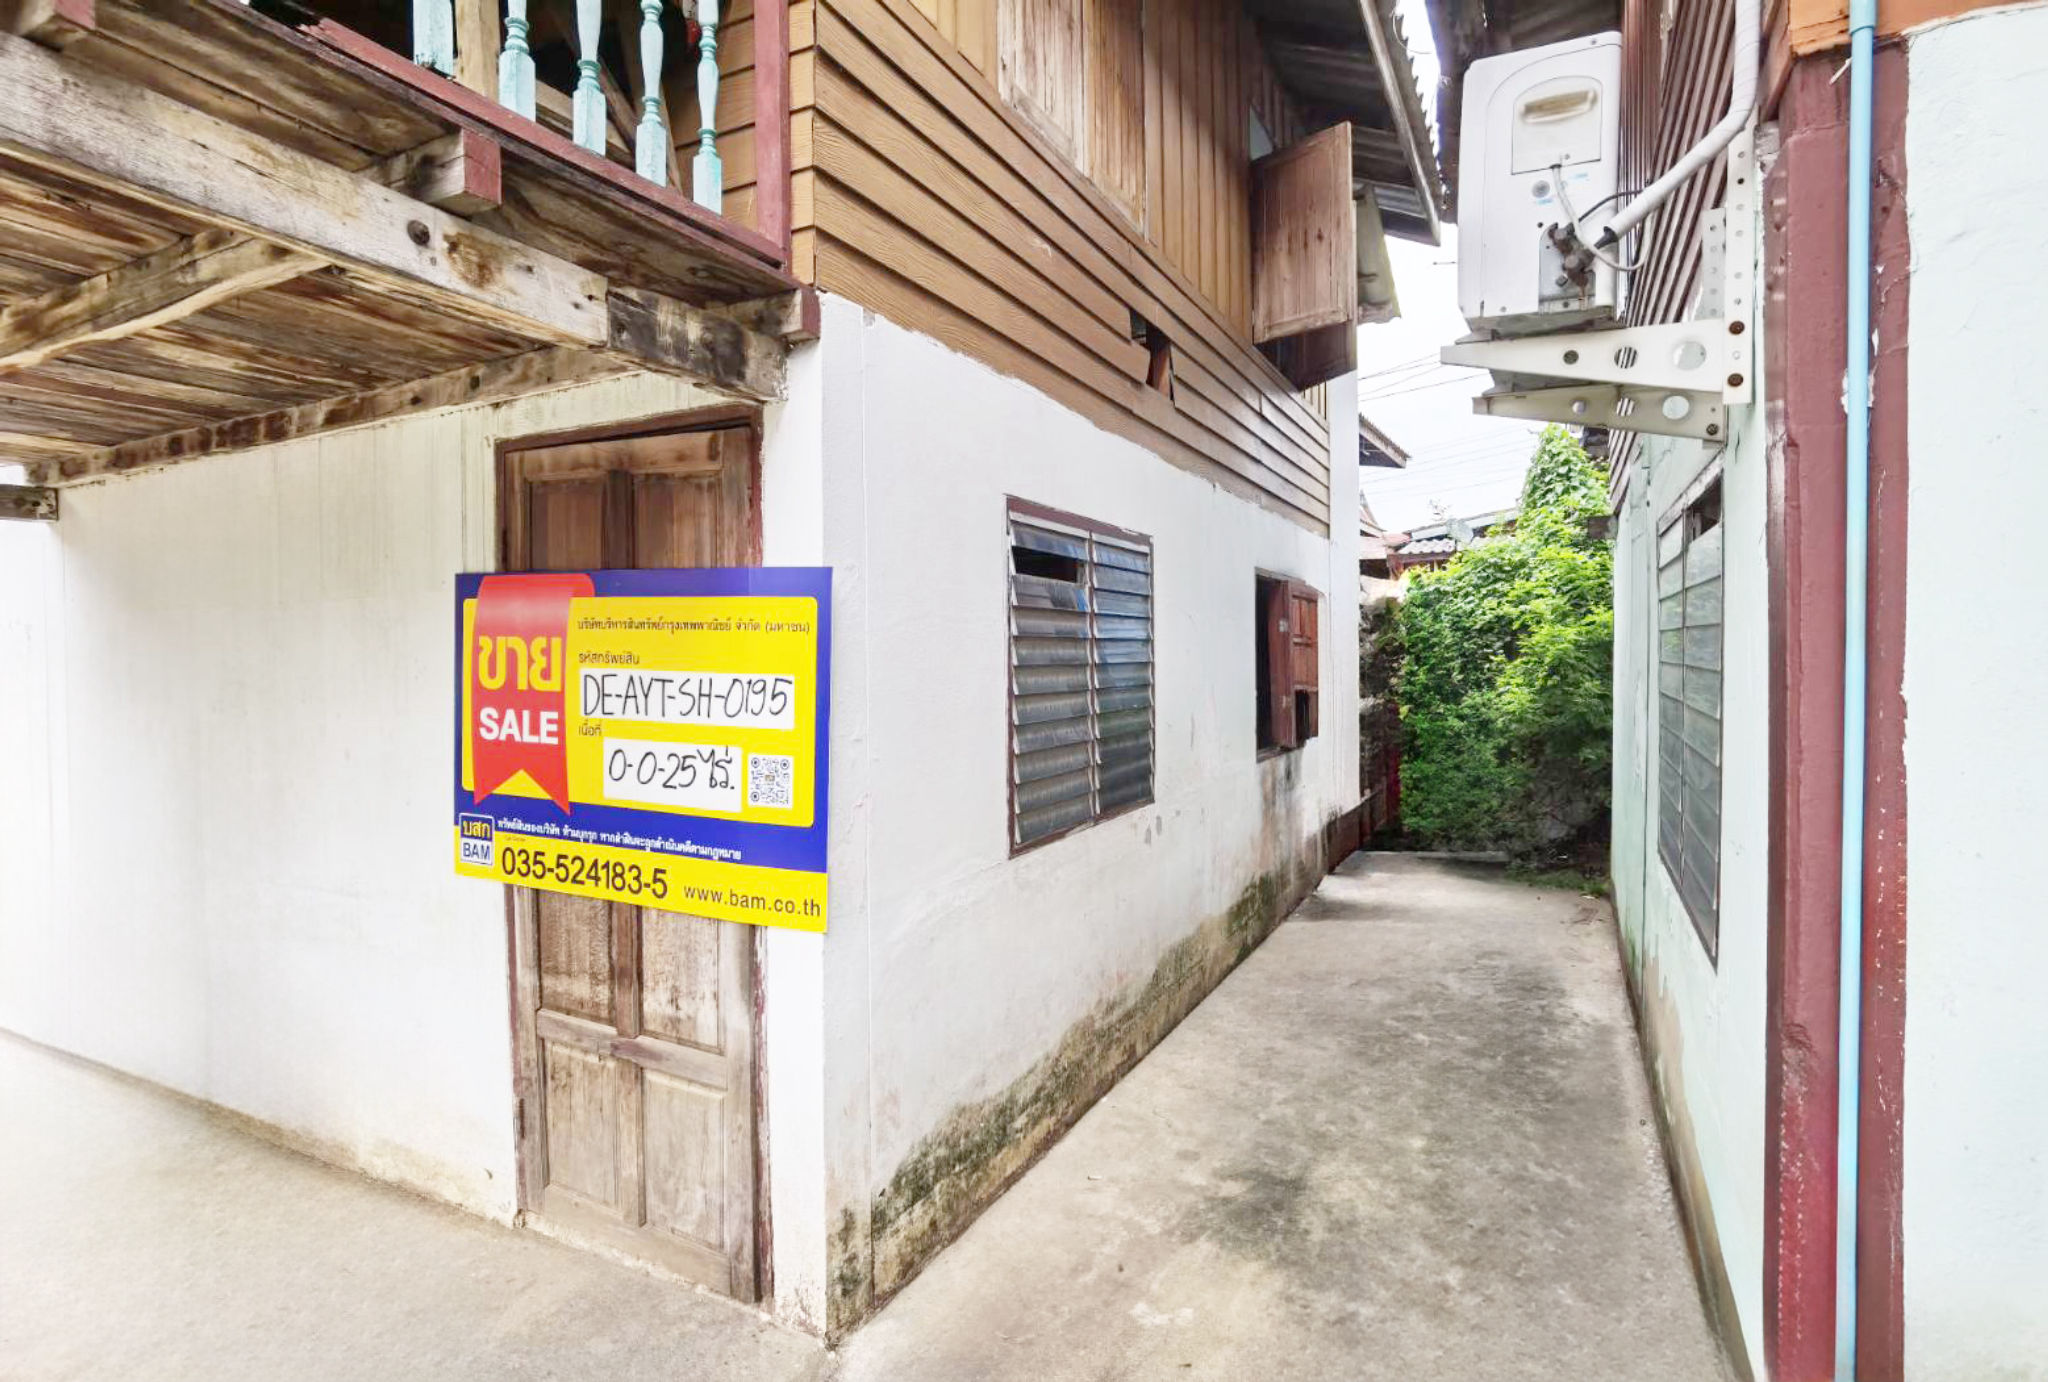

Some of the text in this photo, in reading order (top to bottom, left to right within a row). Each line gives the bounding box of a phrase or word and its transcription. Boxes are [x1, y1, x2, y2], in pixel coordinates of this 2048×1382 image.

[736, 618, 761, 632] จำกัด
[766, 620, 811, 635] (มหาชน)
[478, 635, 562, 692] ขาย
[582, 673, 793, 718] DE-AYT-SH-0195
[479, 707, 559, 745] SALE
[462, 820, 491, 841] บสก
[463, 842, 491, 861] BAM
[502, 847, 669, 900] 035-524183-5
[684, 884, 821, 918] www.bam.co.th
